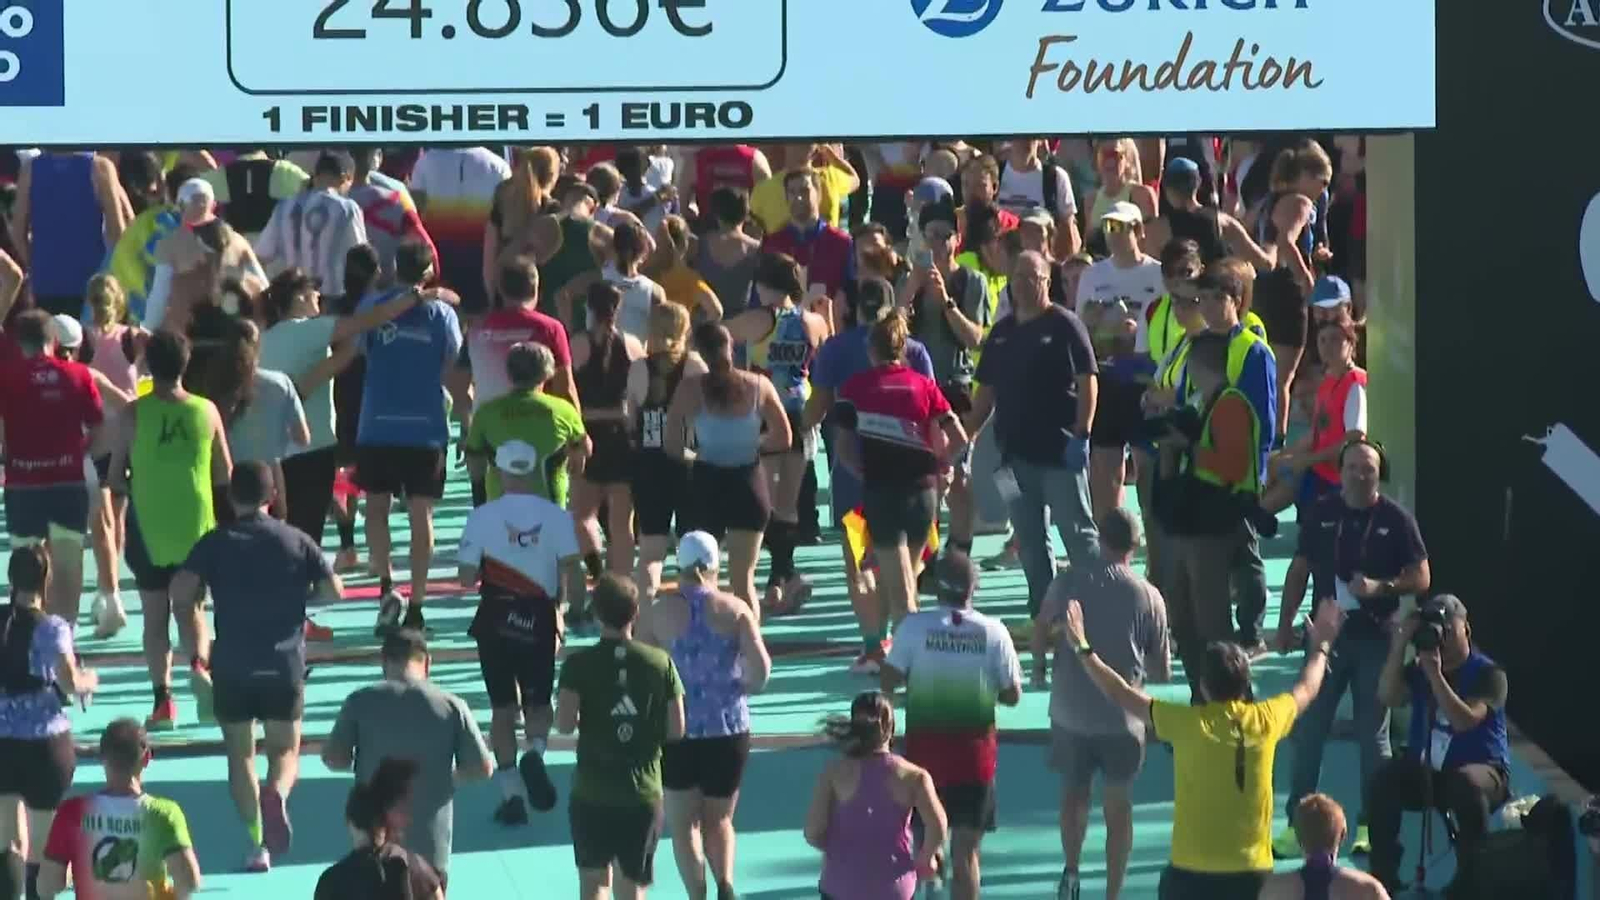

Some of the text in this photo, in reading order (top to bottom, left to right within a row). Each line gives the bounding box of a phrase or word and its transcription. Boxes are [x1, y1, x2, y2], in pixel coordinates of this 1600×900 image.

[1025, 32, 1325, 100] Foundation
[262, 100, 754, 133] 1 FINISHER = 1 EURO
[507, 611, 536, 631] Paul
